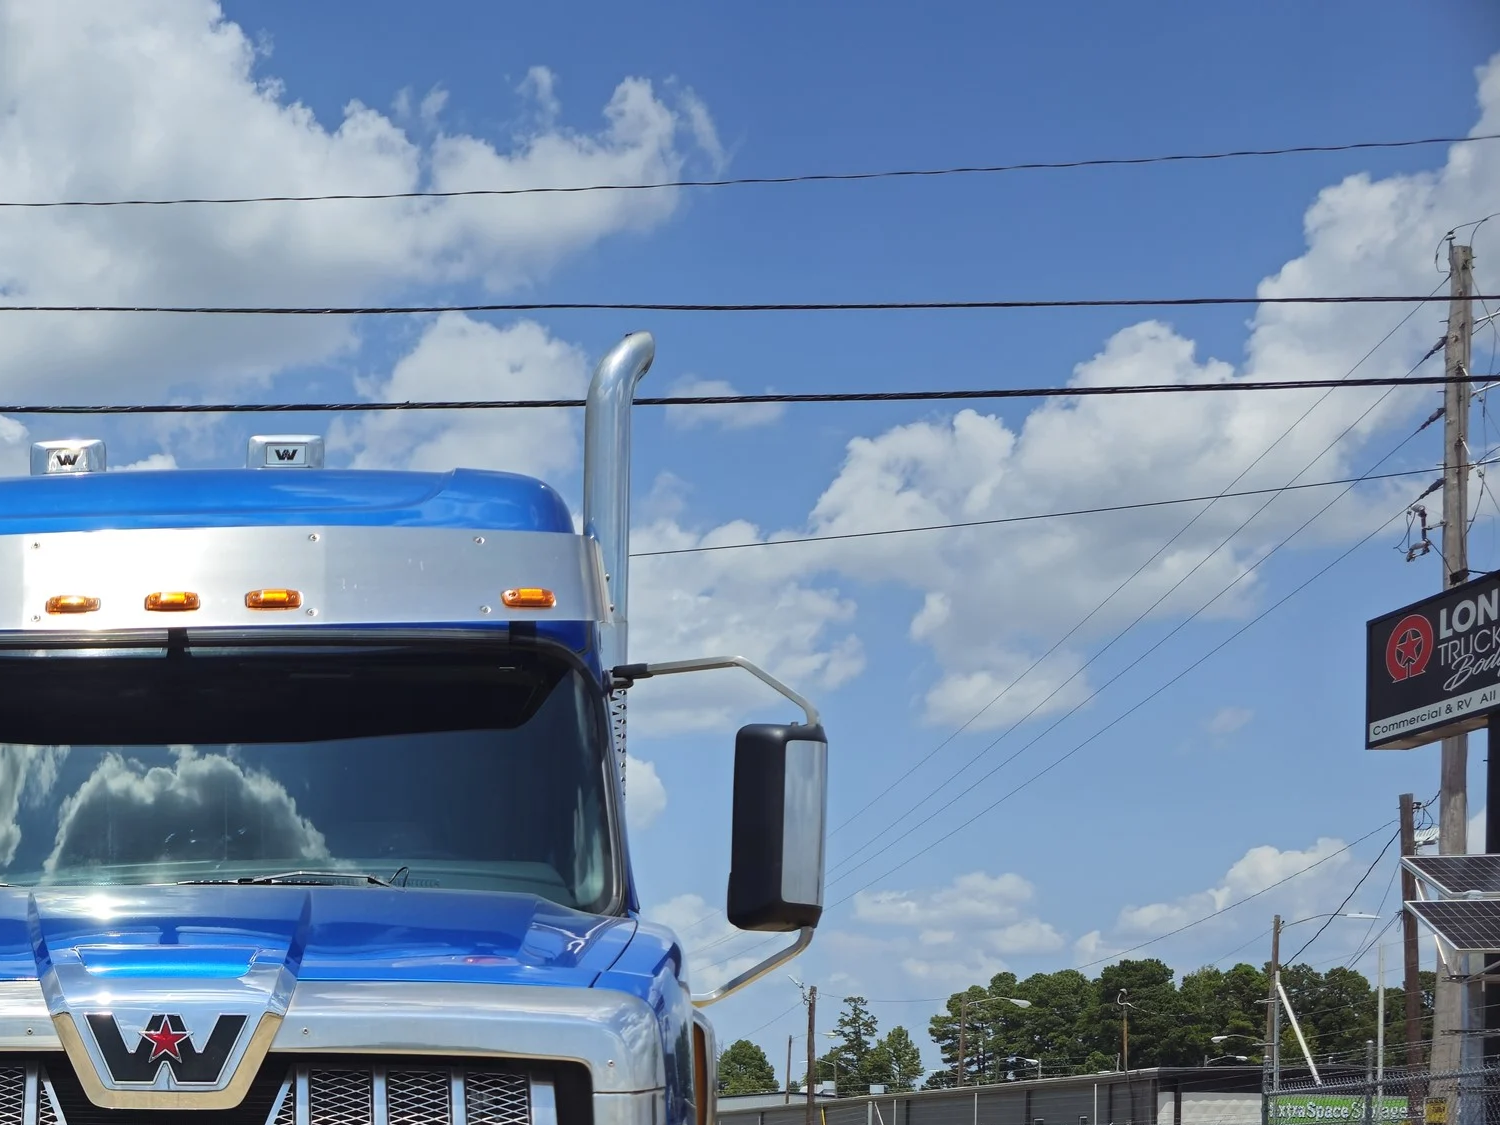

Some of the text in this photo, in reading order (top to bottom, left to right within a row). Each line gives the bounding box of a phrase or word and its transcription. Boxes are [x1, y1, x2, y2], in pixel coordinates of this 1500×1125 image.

[1440, 588, 1499, 640] LON
[1443, 646, 1500, 691] Bod
[1373, 690, 1496, 735] Commercial & RV All
[1307, 1102, 1349, 1122] Space
